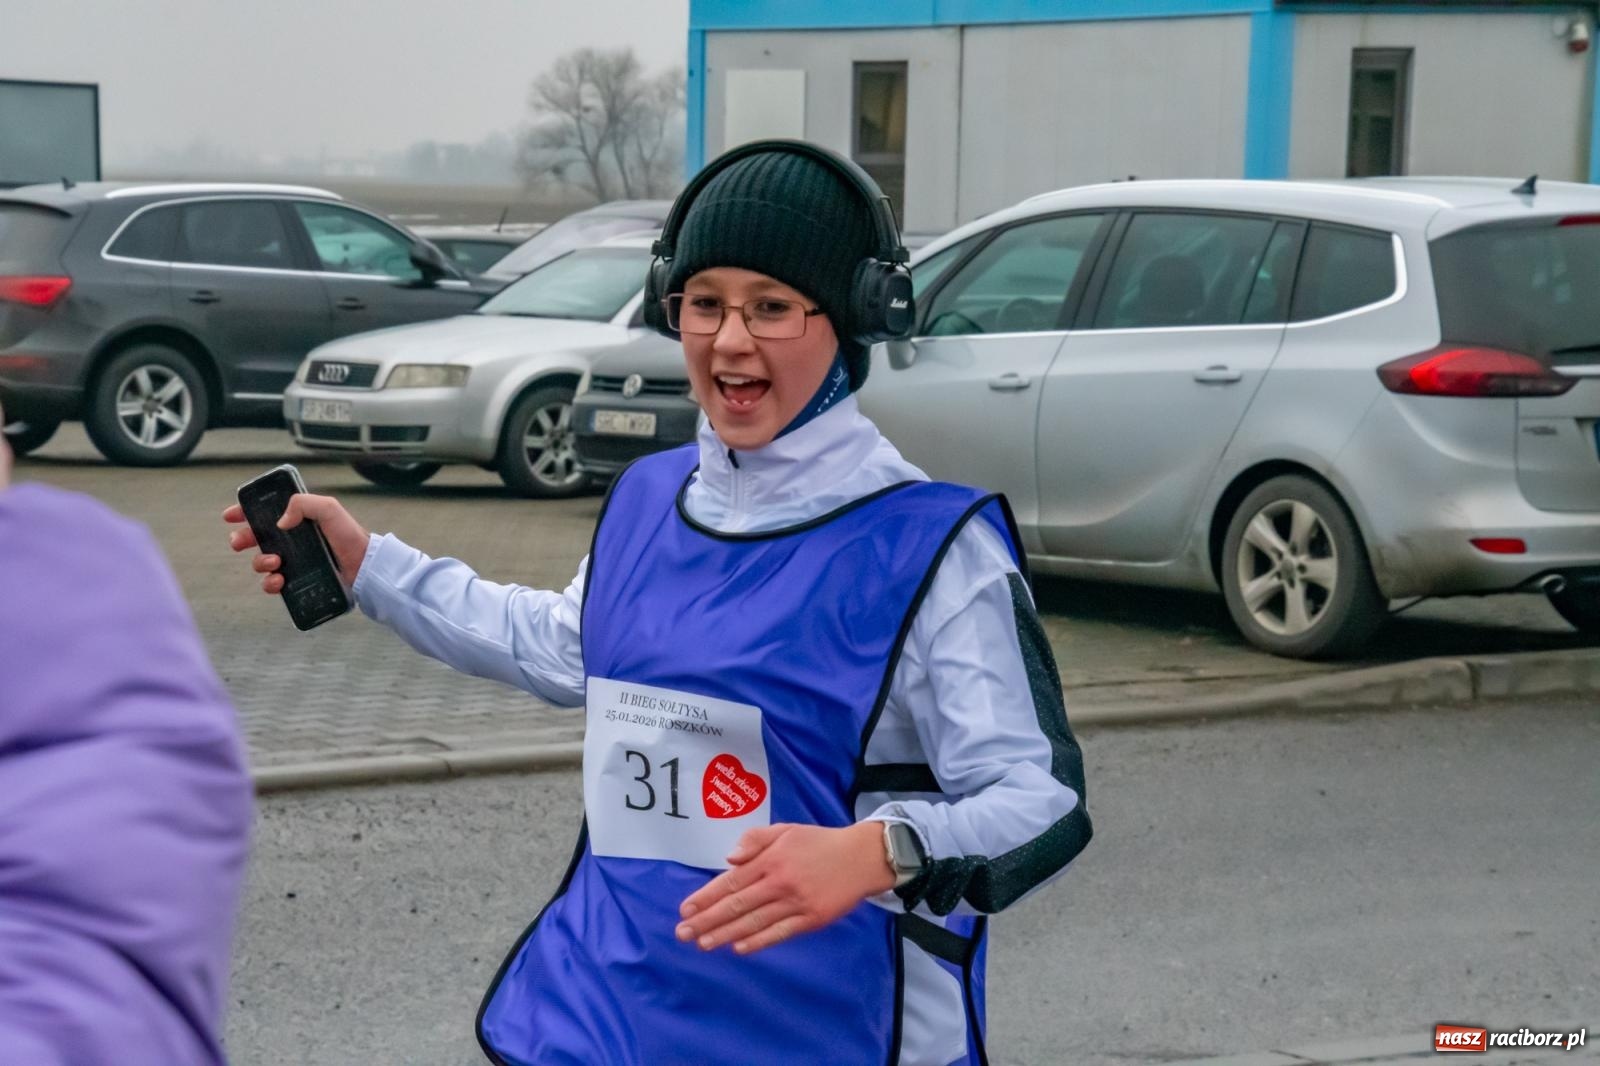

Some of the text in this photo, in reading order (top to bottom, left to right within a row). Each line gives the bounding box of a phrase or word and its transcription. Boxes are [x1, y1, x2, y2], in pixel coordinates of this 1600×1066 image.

[620, 692, 709, 721] II BIEG SOŁTYSA
[605, 709, 724, 736] 25.01.2026 ROSZKÓW
[625, 750, 690, 819] 31
